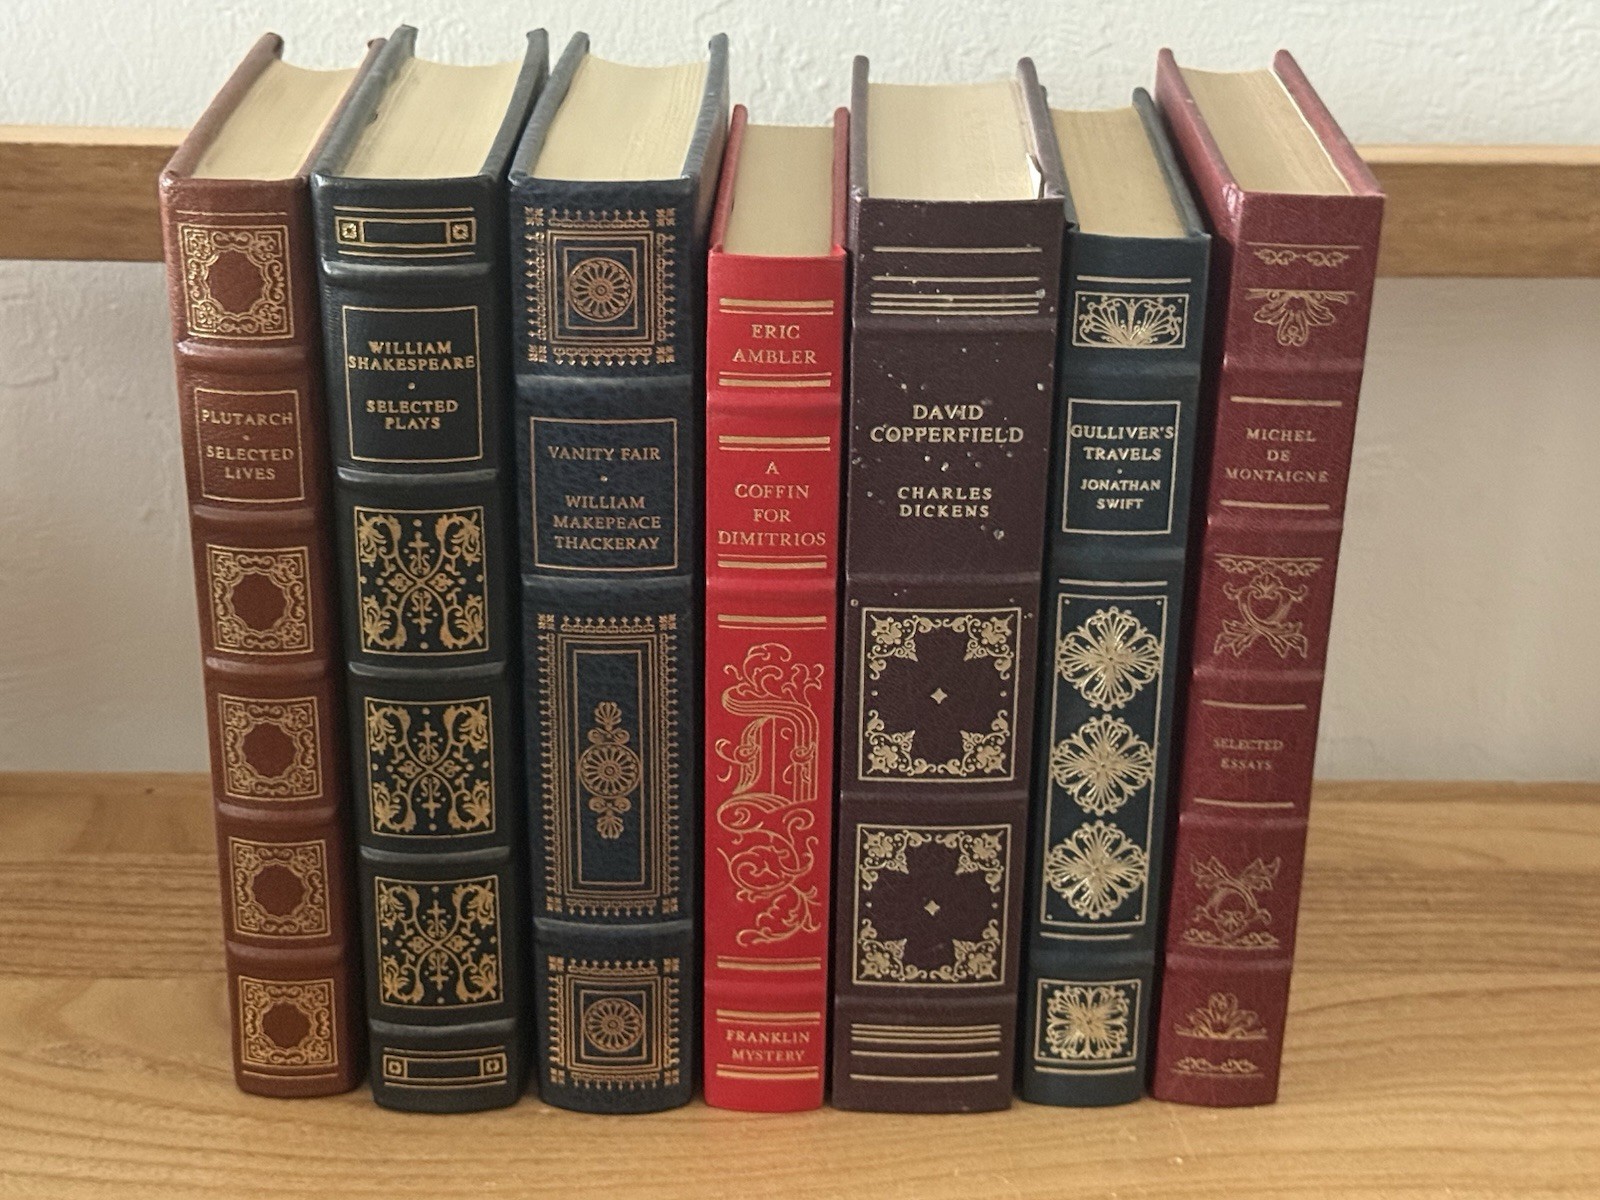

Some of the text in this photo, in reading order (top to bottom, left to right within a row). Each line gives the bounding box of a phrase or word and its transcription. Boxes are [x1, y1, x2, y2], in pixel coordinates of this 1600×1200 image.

[752, 325, 801, 340] ERIC
[368, 341, 452, 356] WILLIAM
[348, 355, 477, 371] SHAKESPEARE
[732, 349, 818, 365] AMBLER
[366, 399, 459, 415] SELECTED
[912, 404, 985, 421] DAVID
[201, 410, 293, 427] PLUTARCH
[384, 416, 441, 431] PLAYS
[870, 426, 1024, 444] COPPERFIELD
[1070, 425, 1174, 440] GULLIVER'S
[1246, 428, 1317, 442] MICHEL
[206, 445, 294, 462] SELECTED
[547, 446, 662, 461] VANITY FAIR
[1083, 446, 1162, 462] TRAVELS
[1266, 448, 1291, 462] DE
[224, 466, 275, 481] LIVES
[765, 461, 780, 475] A
[1225, 468, 1330, 484] MONTAIGNE
[734, 483, 810, 500] COFFIN
[1081, 478, 1162, 492] JONATHAN
[897, 486, 993, 501] CHARLES
[565, 495, 645, 510] WILLIAM
[1096, 497, 1144, 510] SWIFT
[753, 508, 792, 524] FOR
[899, 504, 990, 518] DICKENS
[552, 515, 662, 530] MAKEPEACE
[554, 536, 660, 551] THACKERAY
[717, 530, 826, 547] DIMITRIOS
[1213, 738, 1284, 752] SELECTED
[1221, 757, 1272, 771] ESSAYS
[726, 1028, 811, 1044] FRANKLIN
[731, 1047, 805, 1062] MYSTERY
